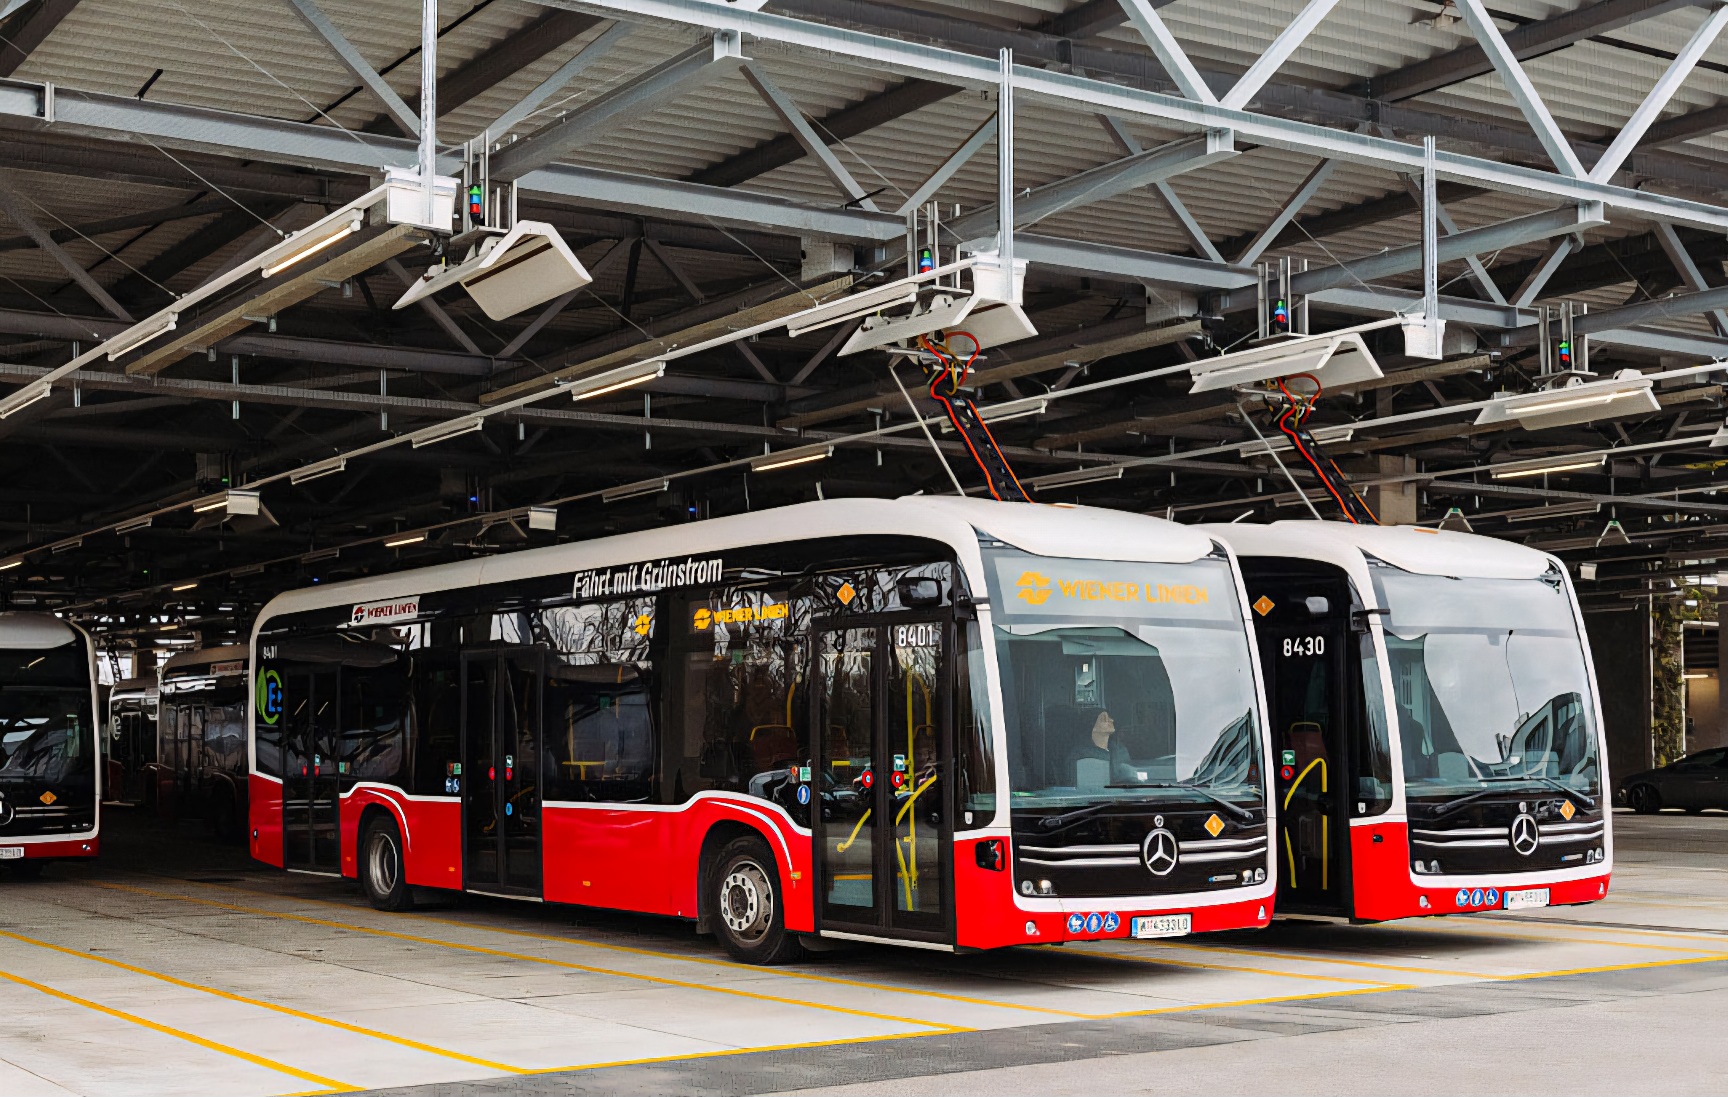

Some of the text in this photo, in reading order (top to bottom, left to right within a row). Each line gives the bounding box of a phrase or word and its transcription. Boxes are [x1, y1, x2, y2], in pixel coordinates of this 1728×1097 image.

[572, 557, 723, 599] Fährt mit Grünstrom
[1058, 579, 1209, 604] WIENER LINIEN
[898, 625, 933, 647] 8401
[1283, 635, 1325, 657] 8430
